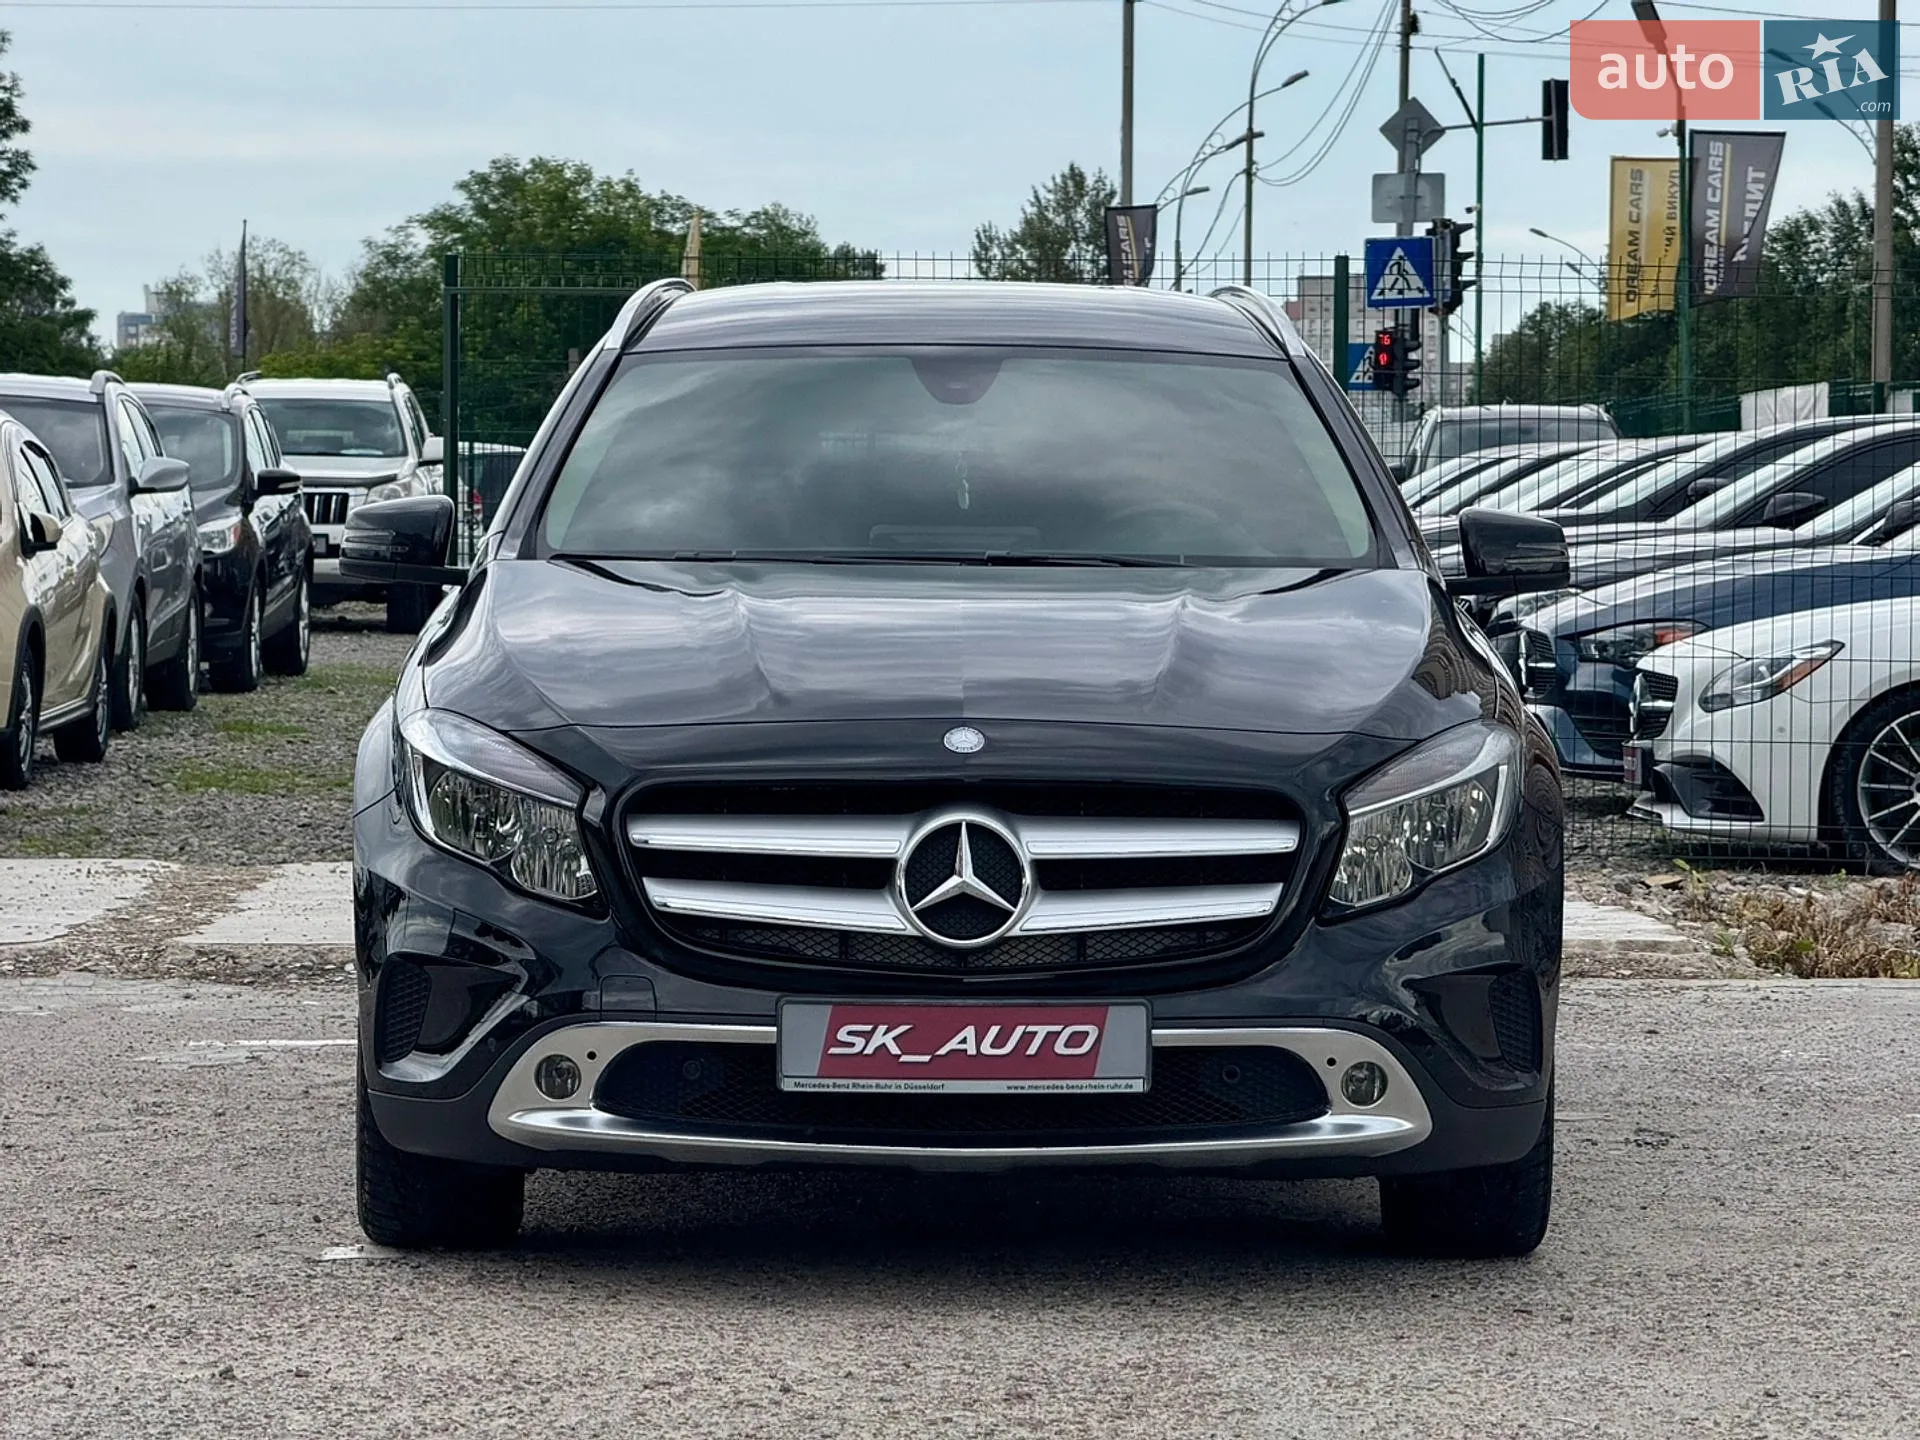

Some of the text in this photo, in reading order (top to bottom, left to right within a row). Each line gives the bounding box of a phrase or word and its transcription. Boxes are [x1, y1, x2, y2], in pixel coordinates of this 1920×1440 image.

[1629, 167, 1644, 224] CARS
[1703, 140, 1724, 295] DREAM CARS
[1731, 166, 1766, 262] КДИТ
[1115, 215, 1131, 265] CARS
[1625, 230, 1641, 303] DREAM
[827, 1023, 1099, 1062] SK_AUTO
[793, 1081, 851, 1090] Mercedes-Benz
[894, 1082, 902, 1090] in
[903, 1082, 945, 1091] Düsseldorf
